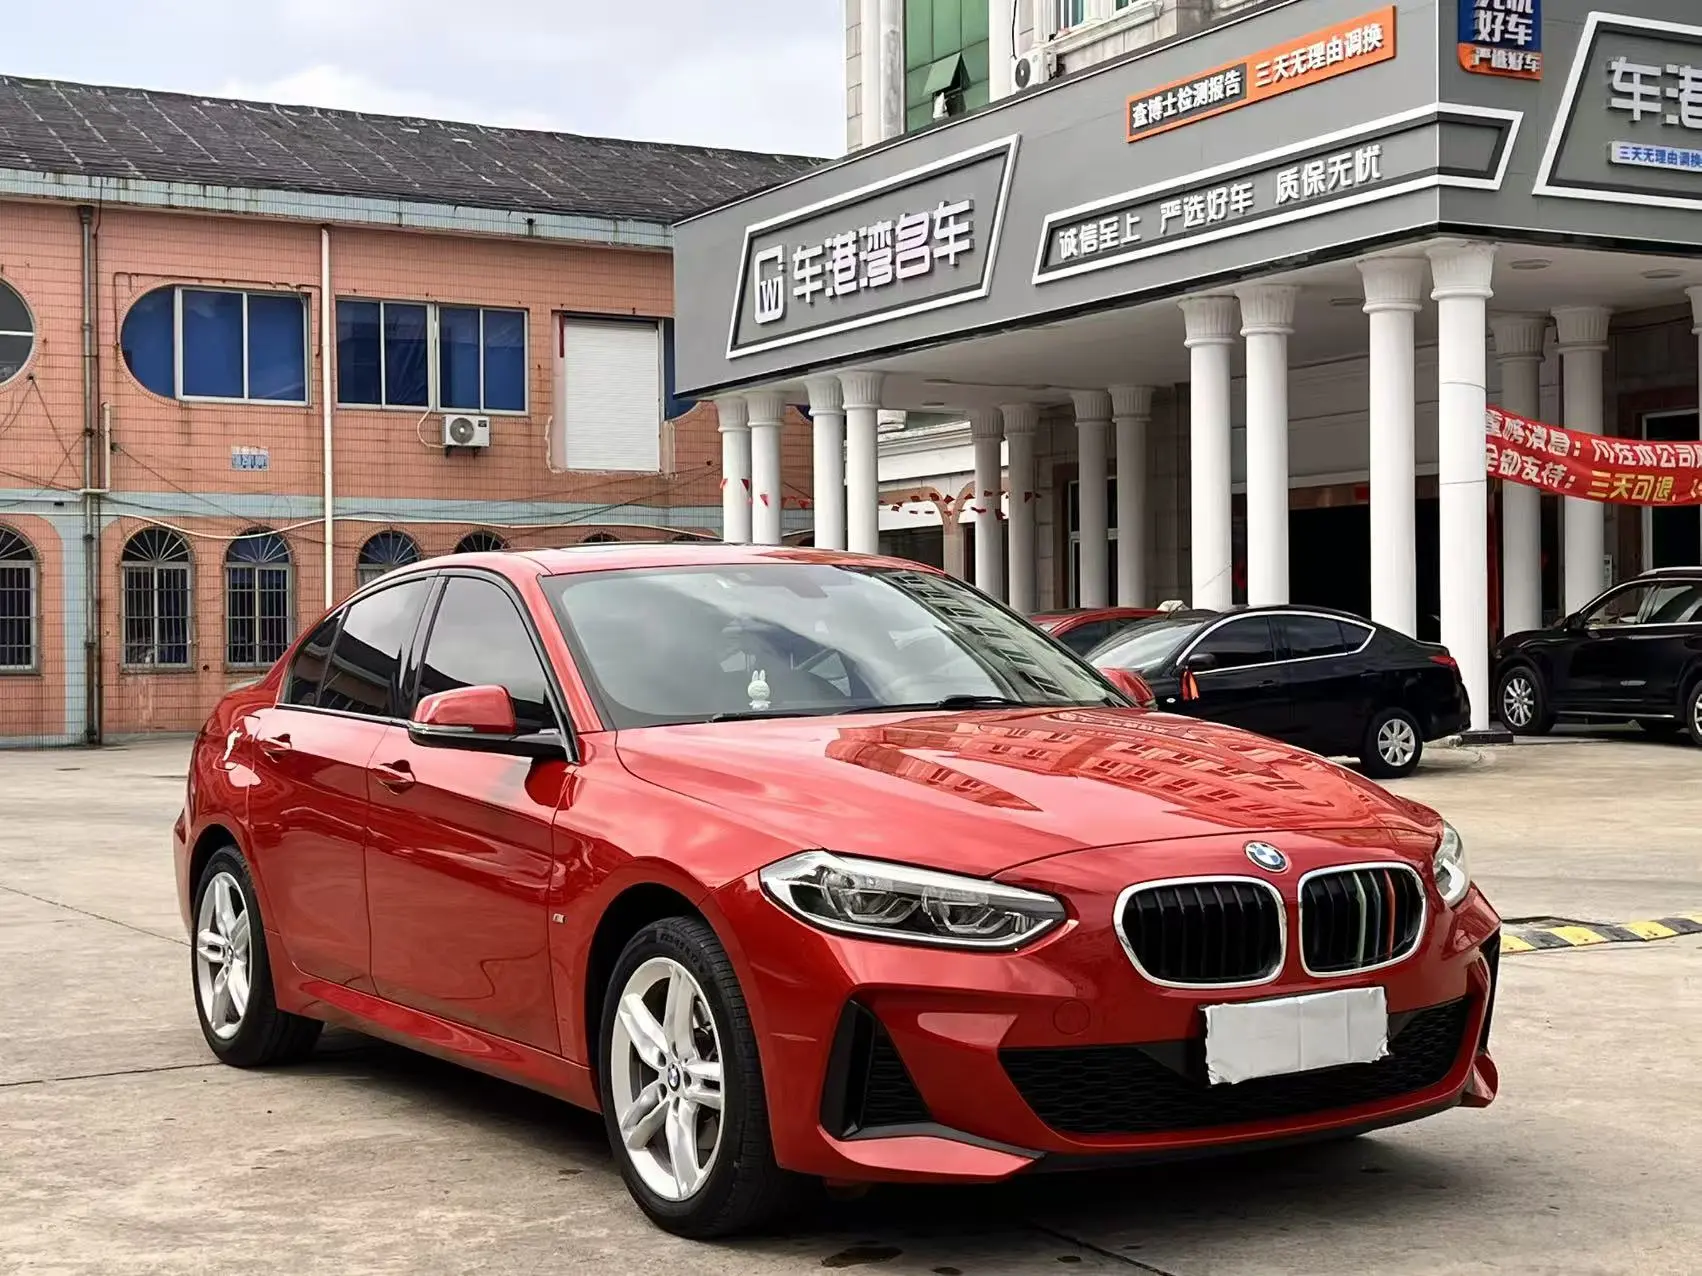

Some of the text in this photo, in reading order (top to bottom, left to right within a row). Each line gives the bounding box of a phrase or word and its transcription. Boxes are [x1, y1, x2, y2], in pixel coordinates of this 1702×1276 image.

[1254, 23, 1384, 88] 三天无理由调换
[1474, 10, 1533, 45] 好车
[1132, 70, 1242, 128] 查博士检测报告
[1058, 144, 1382, 259] 诚信至上 严选好车 质保无忧
[792, 199, 974, 304] 车港湾名车
